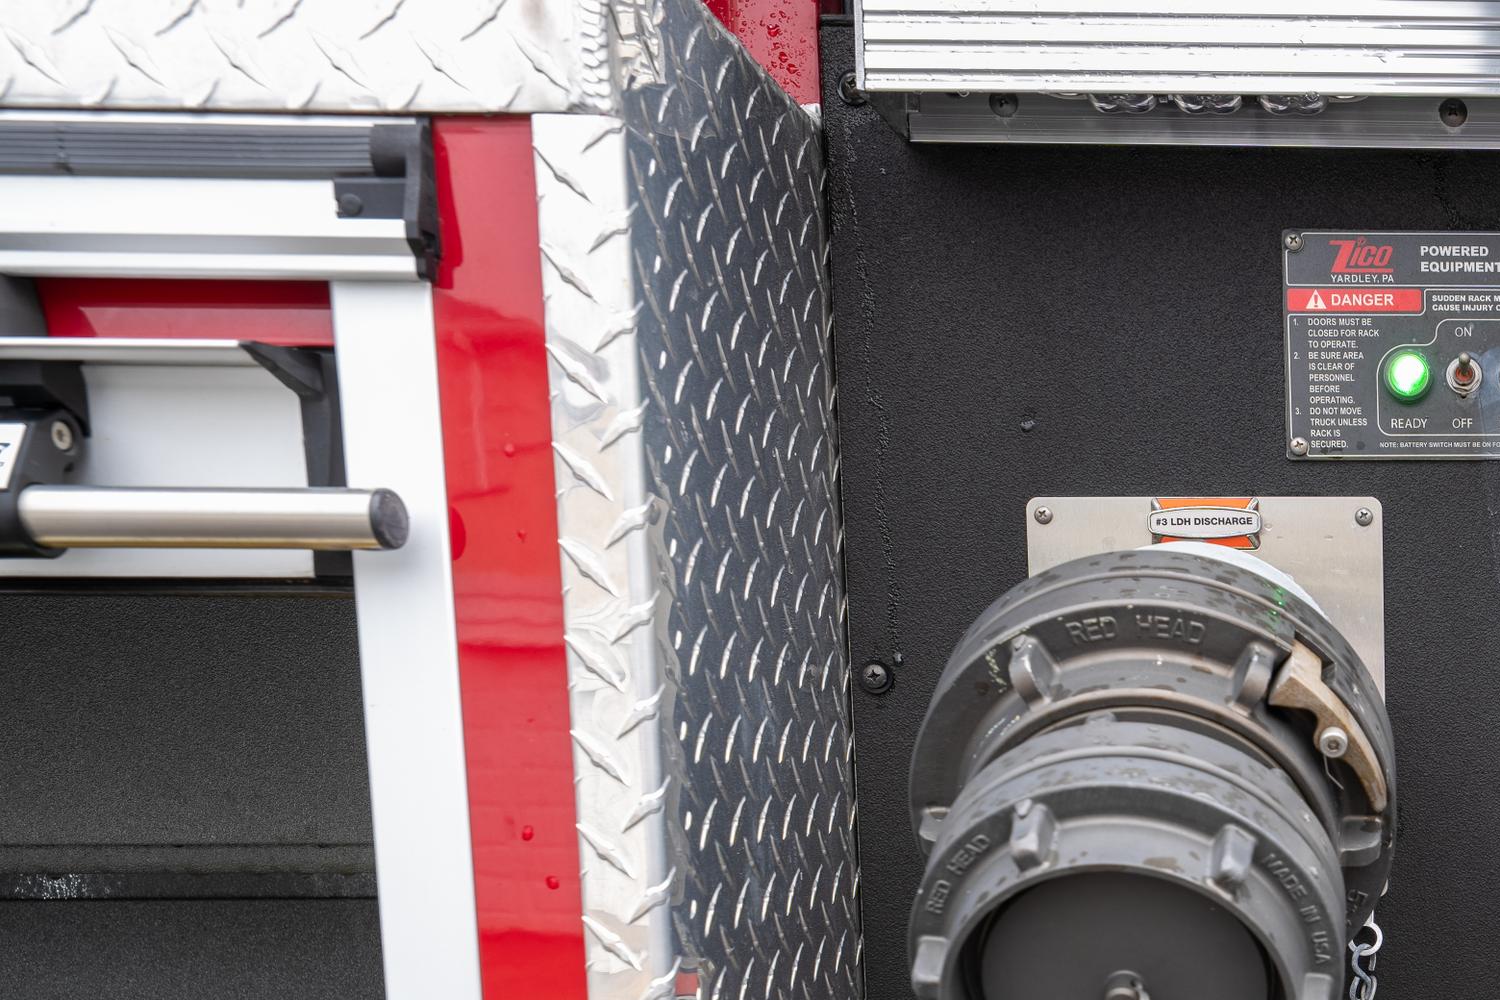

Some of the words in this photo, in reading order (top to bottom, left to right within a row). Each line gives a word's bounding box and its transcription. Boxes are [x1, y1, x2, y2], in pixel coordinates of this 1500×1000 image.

[1420, 245, 1489, 257] POWERED
[1331, 274, 1380, 284] YARDLEY,
[1382, 274, 1394, 283] PA
[1331, 293, 1394, 306] DANGER
[1432, 294, 1466, 302] SUDDEN
[1468, 294, 1492, 302] RACK
[1432, 304, 1460, 312] CAUSE
[1462, 304, 1494, 312] INJURY
[1293, 318, 1299, 326] 1.
[1307, 318, 1337, 326] DOORS
[1338, 318, 1360, 326] MUST
[1361, 318, 1372, 326] BE
[1308, 329, 1339, 337] CLOSED
[1340, 329, 1357, 337] FOR
[1358, 329, 1380, 337] RACK
[1454, 326, 1472, 337] ON
[1308, 340, 1319, 349] TO
[1320, 340, 1359, 349] OPERATE.
[1293, 351, 1300, 360] 2.
[1308, 351, 1319, 360] BE
[1320, 351, 1341, 360] SURE
[1342, 351, 1364, 360] AREA
[1308, 362, 1316, 371] IS
[1317, 362, 1343, 371] CLEAR
[1344, 362, 1355, 371] OF
[1309, 373, 1355, 382] PERSONNEL
[1309, 385, 1340, 393] BEFORE
[1309, 396, 1356, 404] OPERATING.
[1295, 407, 1302, 415] 3.
[1309, 407, 1321, 415] DO
[1322, 407, 1338, 415] NOT
[1339, 407, 1362, 416] MOVE
[1310, 418, 1337, 426] TRUCK
[1338, 418, 1368, 426] UNLESS
[1390, 418, 1428, 429] READY
[1452, 418, 1473, 429] OFF
[1310, 429, 1332, 437] RACK
[1333, 429, 1341, 437] IS
[1310, 440, 1349, 448] SECURED.
[1156, 518, 1168, 526] #3
[1170, 517, 1191, 526] LDH
[1193, 516, 1253, 526] DISCHARGE
[1065, 616, 1119, 643] RED
[1135, 614, 1206, 644] HEAD
[926, 879, 952, 914] RED
[946, 834, 991, 876] HEAD
[1262, 853, 1308, 900] MADE
[1311, 931, 1331, 964] USA
